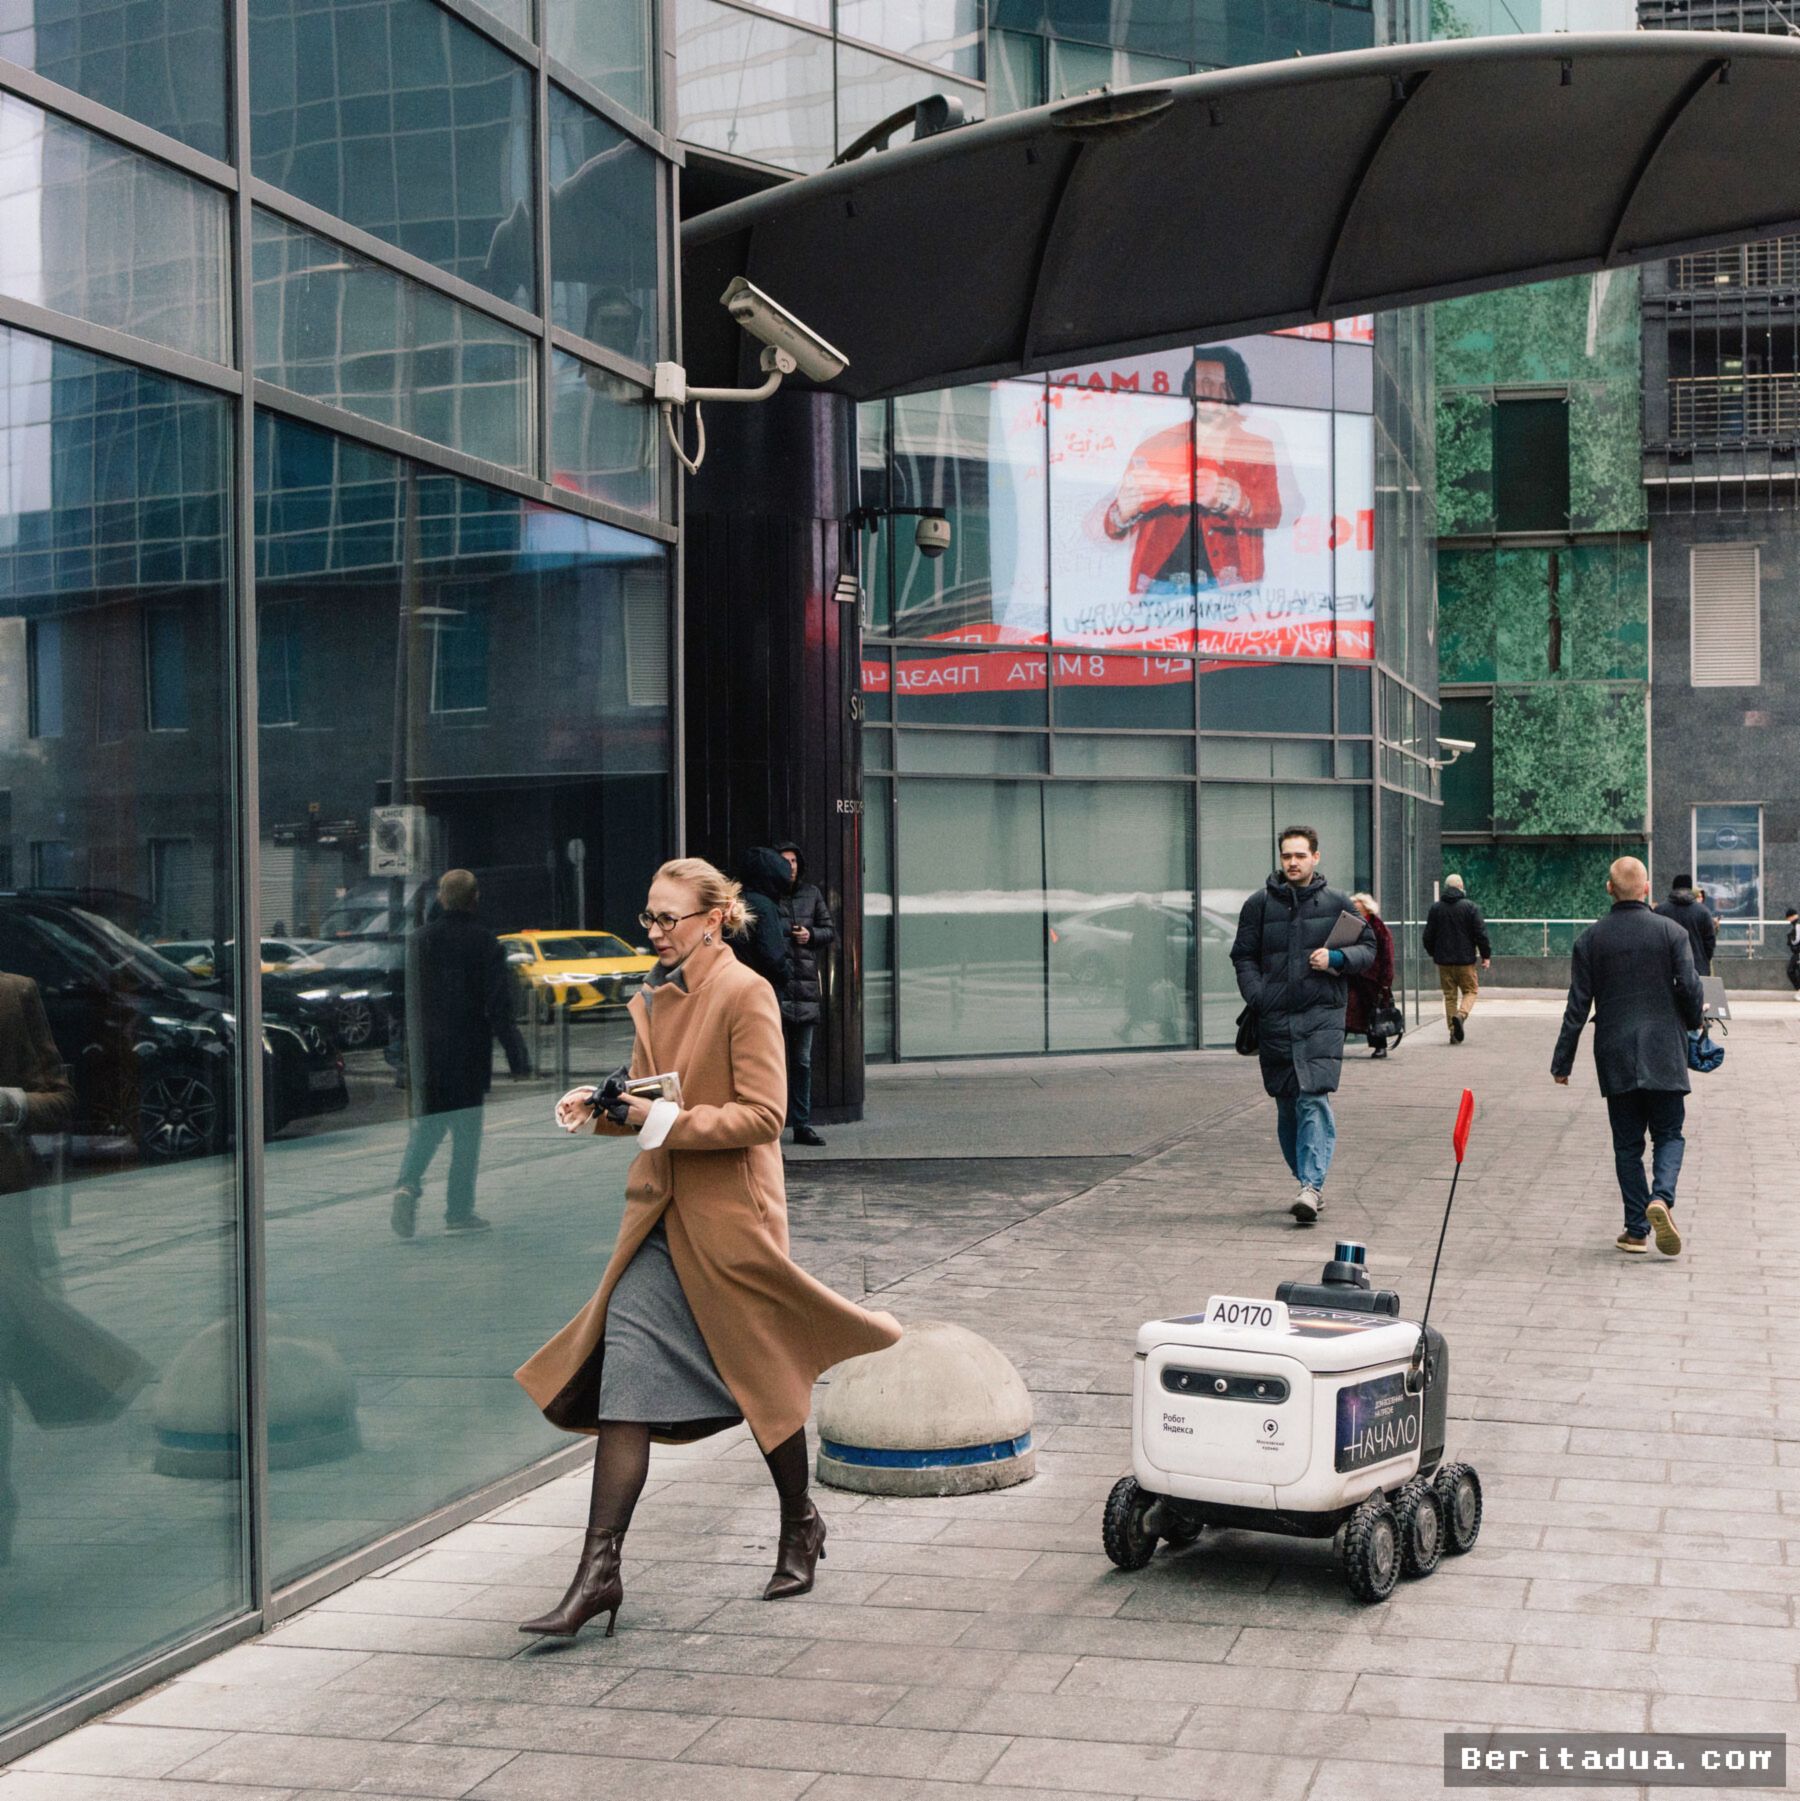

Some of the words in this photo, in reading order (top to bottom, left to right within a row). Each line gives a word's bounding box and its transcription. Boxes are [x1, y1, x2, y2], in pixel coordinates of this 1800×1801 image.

[1163, 1412, 1185, 1424] Робот
[1163, 1422, 1194, 1435] Яндекса
[1344, 1405, 1417, 1462] НАЧАЛО
